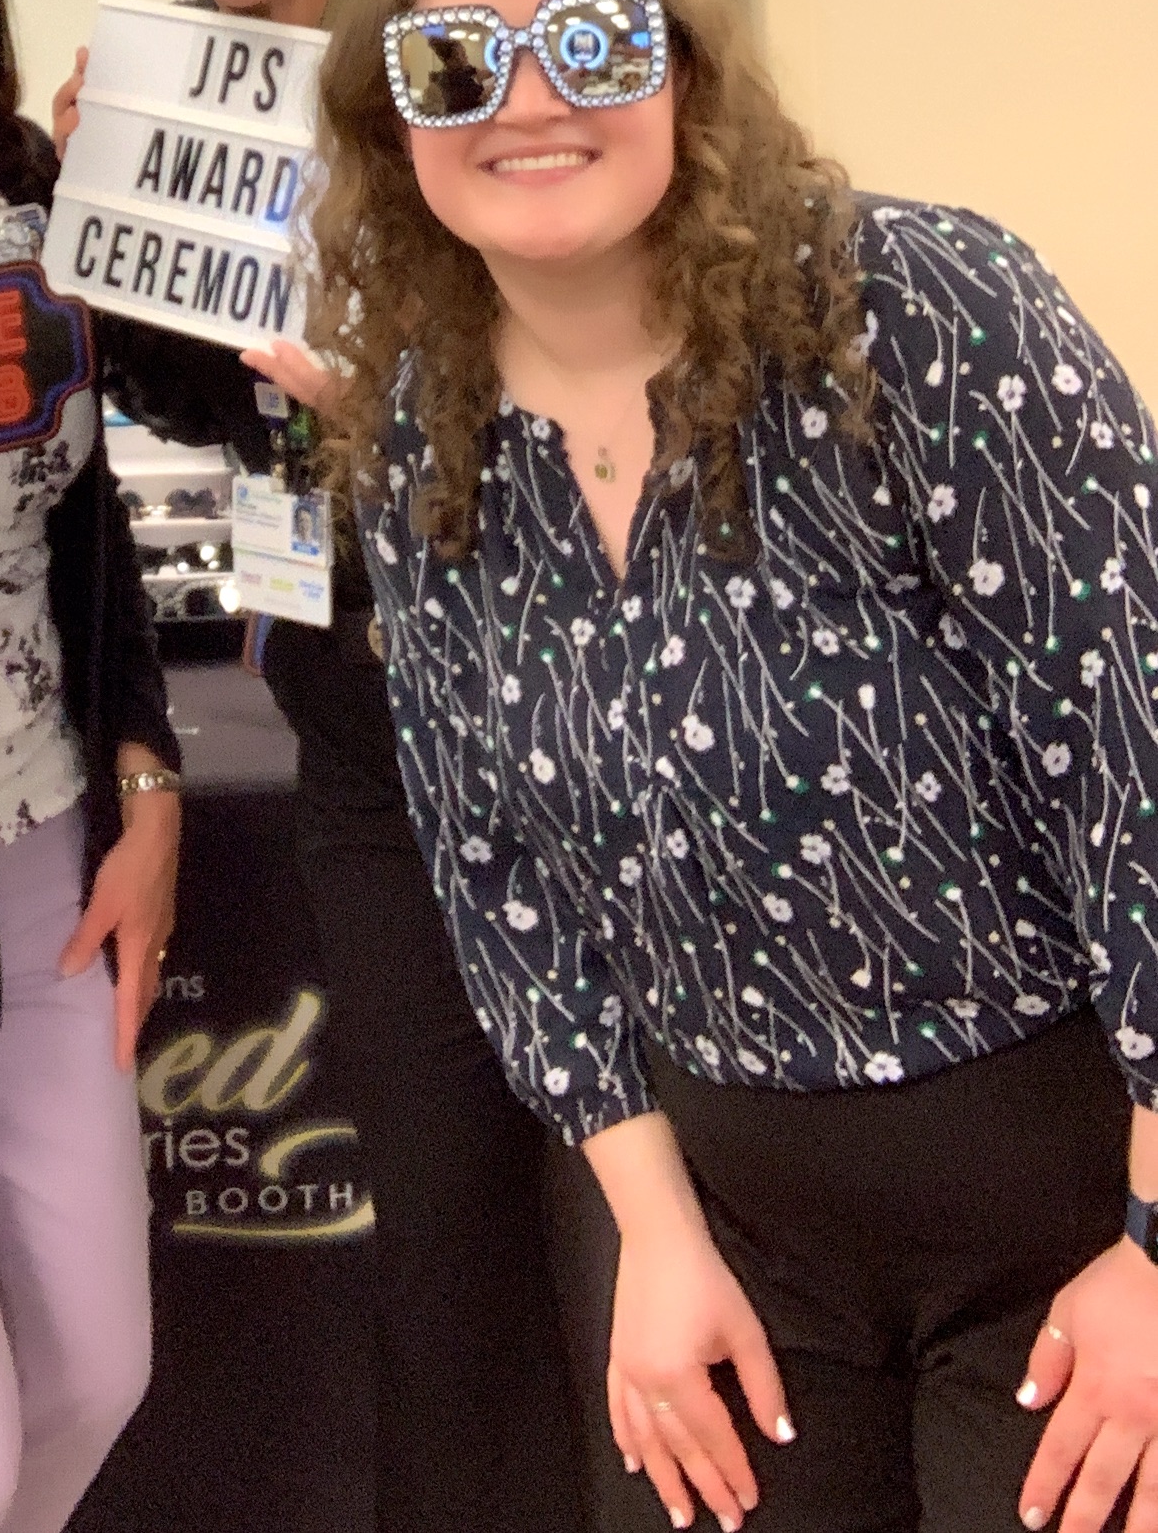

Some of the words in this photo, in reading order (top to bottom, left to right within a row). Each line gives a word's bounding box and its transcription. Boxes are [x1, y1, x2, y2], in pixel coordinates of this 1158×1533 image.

[189, 34, 285, 112] JPS
[136, 128, 299, 222] AWARD
[73, 215, 295, 333] CEREMON
[185, 1181, 354, 1217] BOOTH
